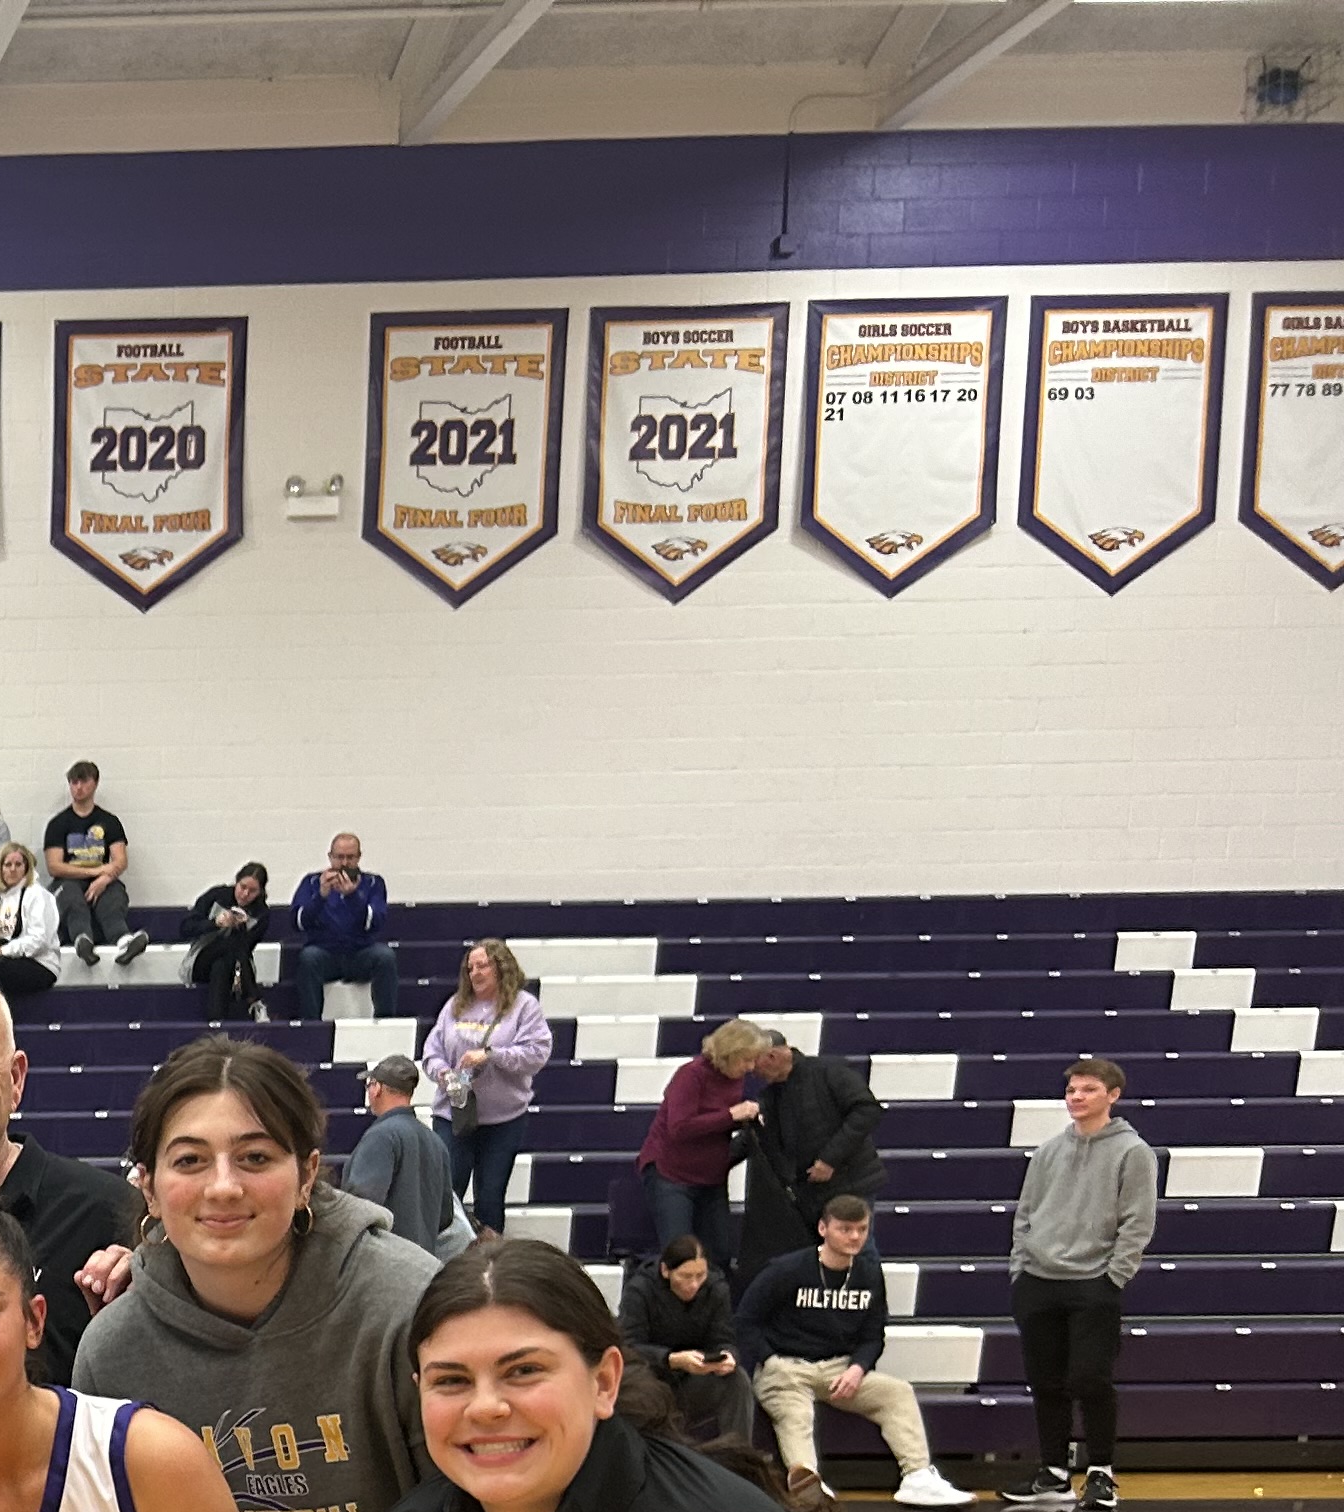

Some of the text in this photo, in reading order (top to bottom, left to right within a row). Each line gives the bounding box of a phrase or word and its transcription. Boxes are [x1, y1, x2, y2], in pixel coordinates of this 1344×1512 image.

[858, 323, 952, 338] GIRLS SOCCER
[1062, 319, 1192, 334] BOYS BASKETBALL
[1282, 316, 1321, 330] GIRLS
[434, 336, 503, 351] FOOTBALL
[642, 329, 734, 345] BOYS SOCCER
[117, 344, 184, 359] FOOTBALL
[609, 348, 765, 375] STATE
[826, 341, 983, 370] CHAMPIONSHIPS
[1048, 338, 1204, 366] CHAMPIONSHIPS
[73, 361, 226, 388] STATE
[389, 353, 544, 382] STATE
[869, 370, 938, 387] DISTRICT
[1091, 367, 1160, 383] DISTRICT
[825, 388, 978, 405] 07 08 11 16 17 20
[1047, 387, 1095, 400] 69 03
[1269, 383, 1290, 397] 77
[1295, 383, 1316, 397] 78
[824, 407, 844, 421] 21
[409, 417, 516, 466] 2021
[628, 412, 738, 462] 2021
[89, 426, 206, 472] 2020
[79, 508, 211, 534] FINAL FOUR
[393, 503, 527, 529] FINAL FOUR
[613, 498, 748, 524] FINAL FOUR
[796, 1287, 871, 1310] HILFIGER
[245, 1473, 309, 1497] EAGLES
